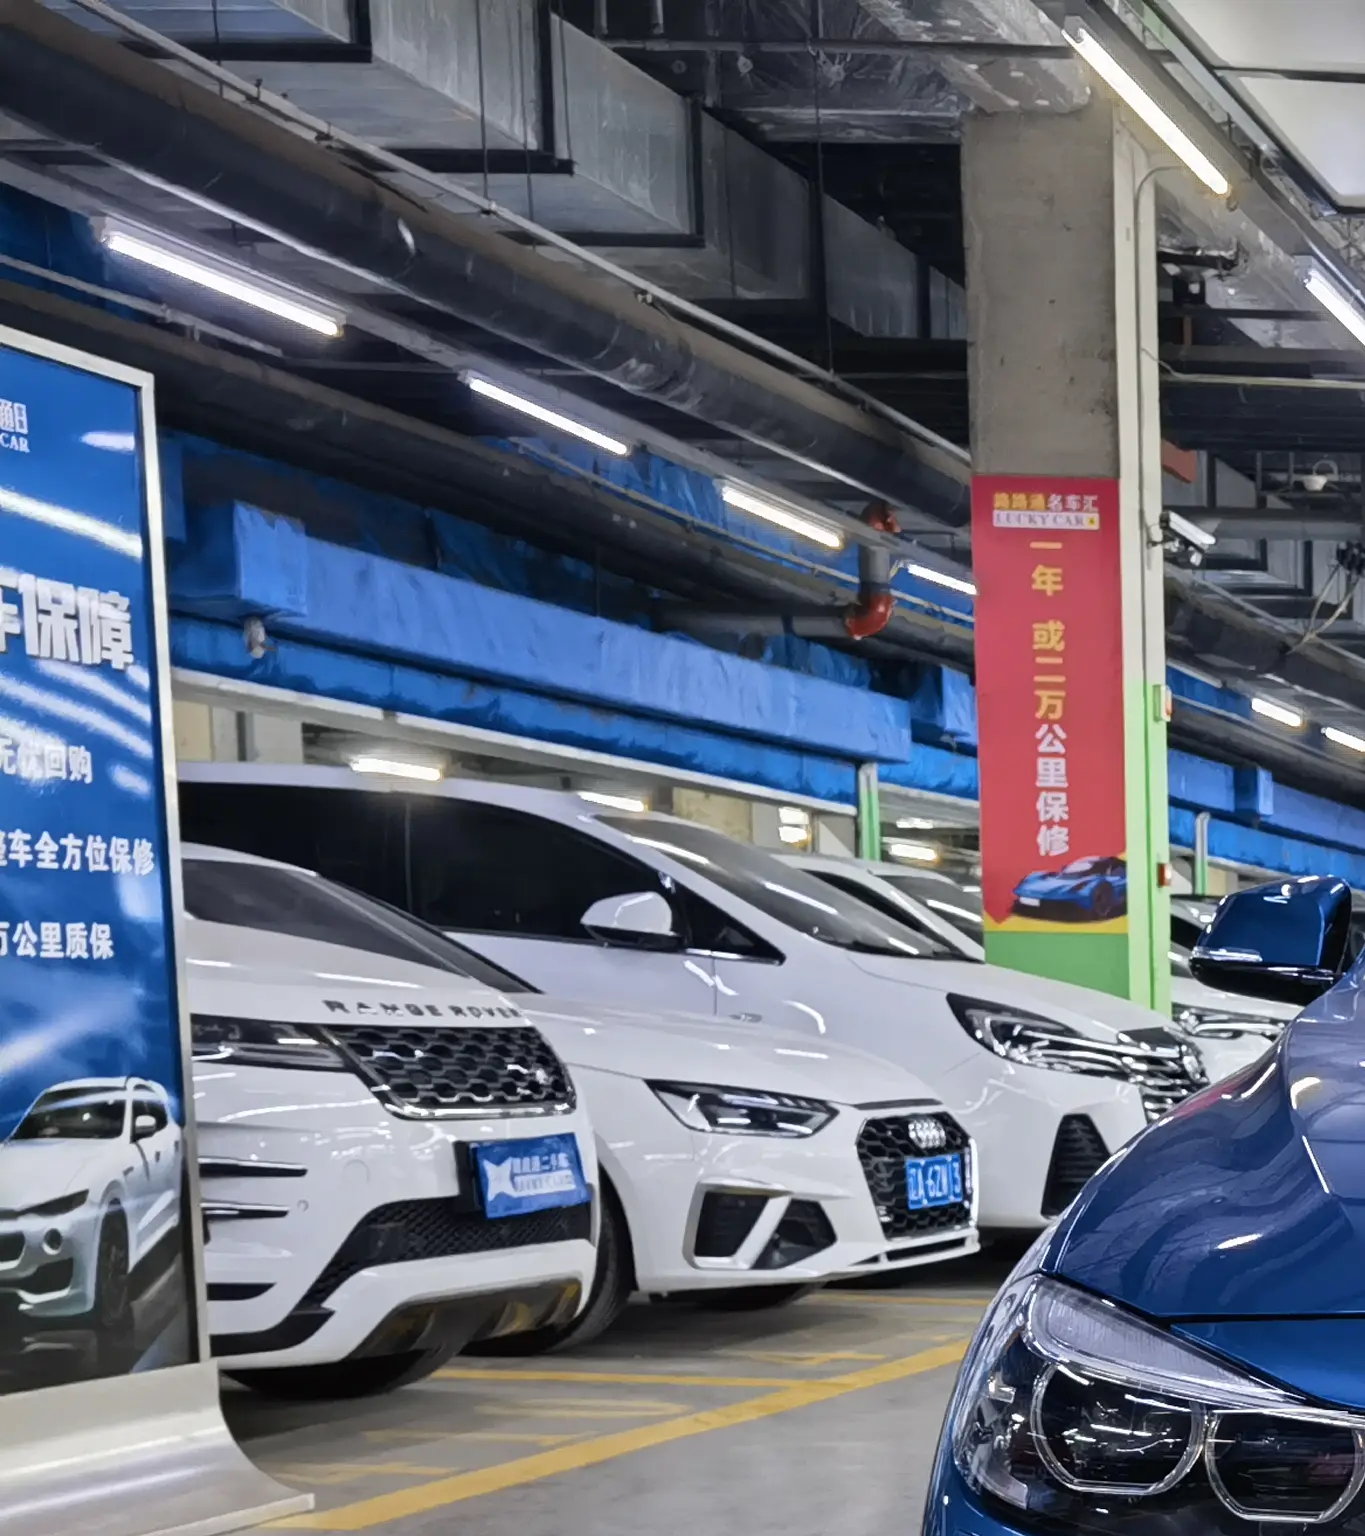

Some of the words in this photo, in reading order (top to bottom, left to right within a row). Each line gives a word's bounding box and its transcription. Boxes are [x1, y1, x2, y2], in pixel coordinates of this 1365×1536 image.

[1032, 619, 1069, 857] 或二万公里保修
[323, 999, 443, 1017] RANGE
